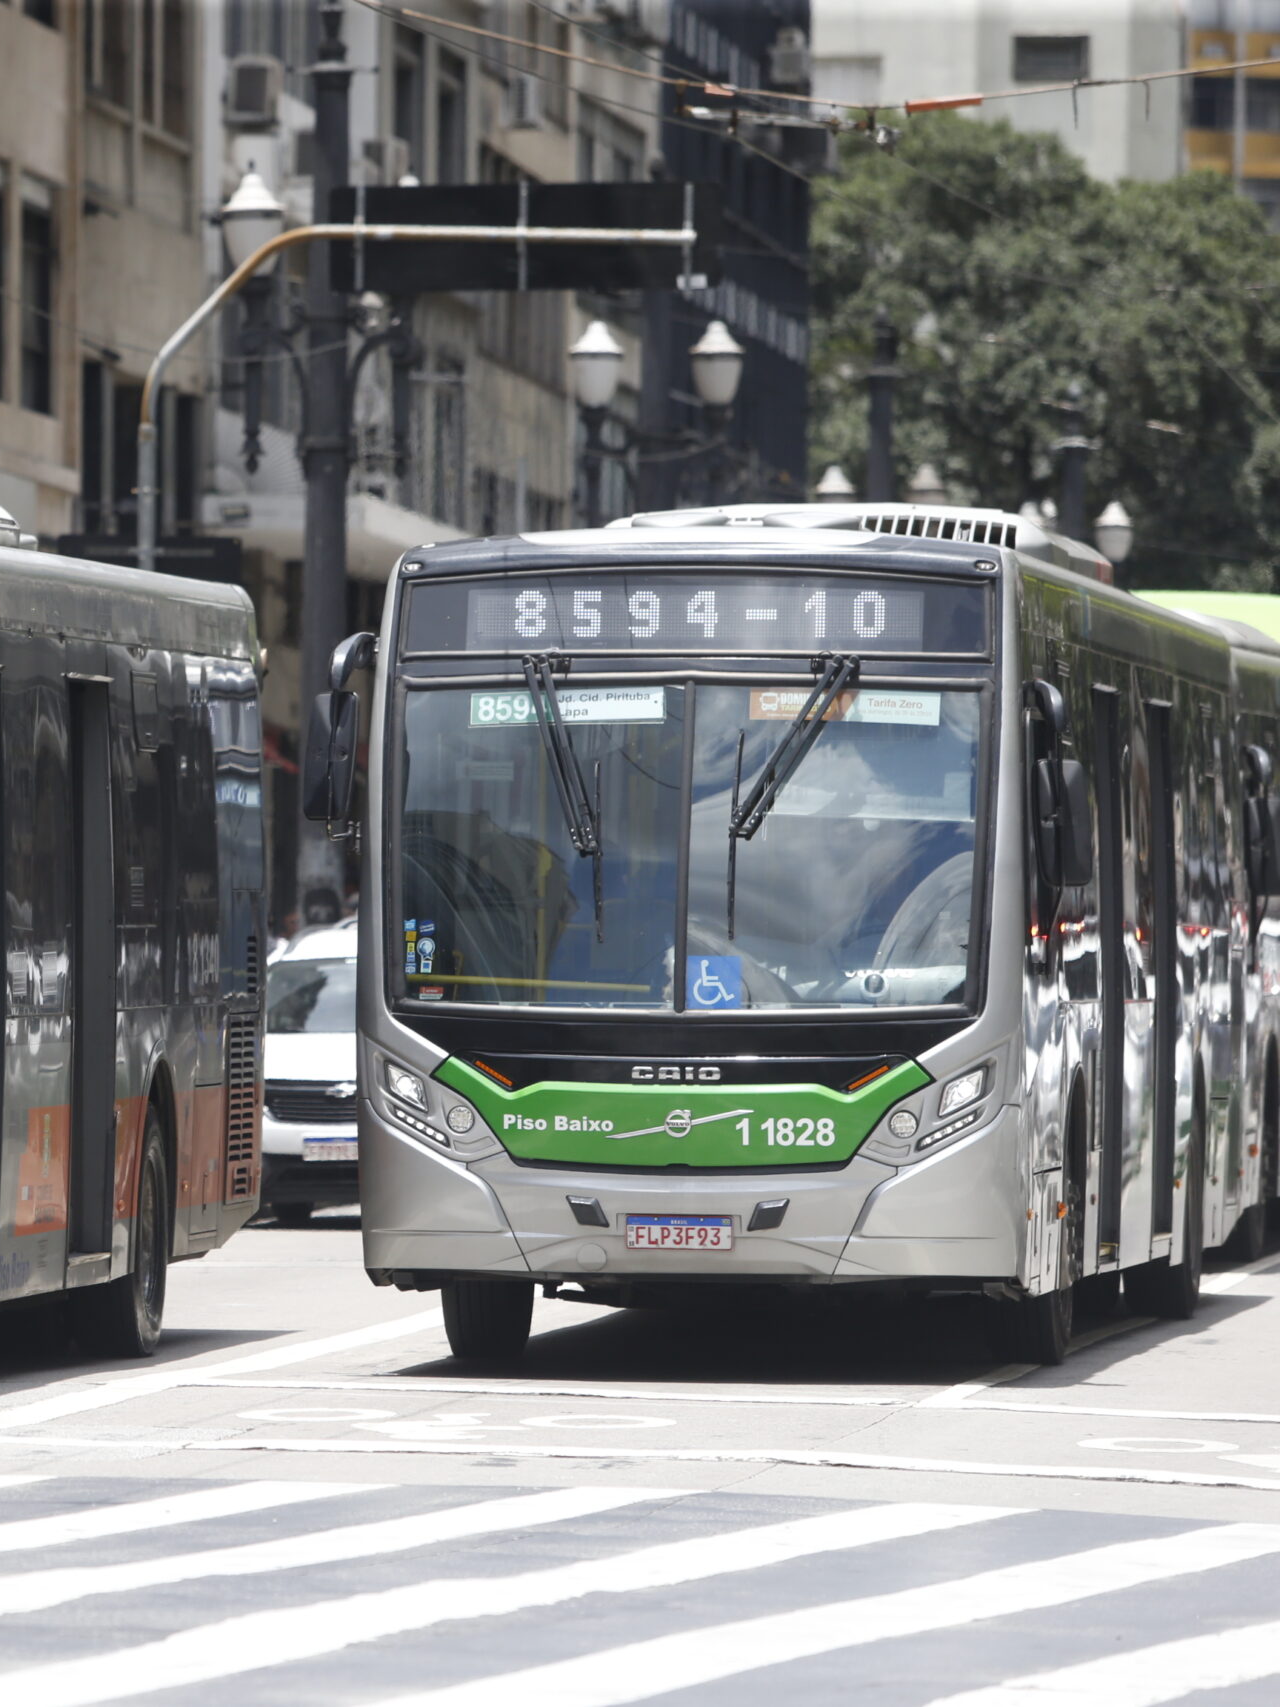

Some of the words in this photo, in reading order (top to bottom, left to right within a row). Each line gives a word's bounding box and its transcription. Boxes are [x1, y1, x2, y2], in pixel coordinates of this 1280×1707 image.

[579, 693, 603, 702] Cid.
[606, 692, 650, 701] Pirituba
[867, 697, 897, 708] Tarifa
[898, 699, 923, 710] Zero
[631, 1065, 721, 1081] CAIO
[503, 1114, 547, 1131] Piso
[554, 1115, 614, 1132] Baixo
[761, 1119, 835, 1146] 1828
[635, 1226, 721, 1246] FLP3F93
